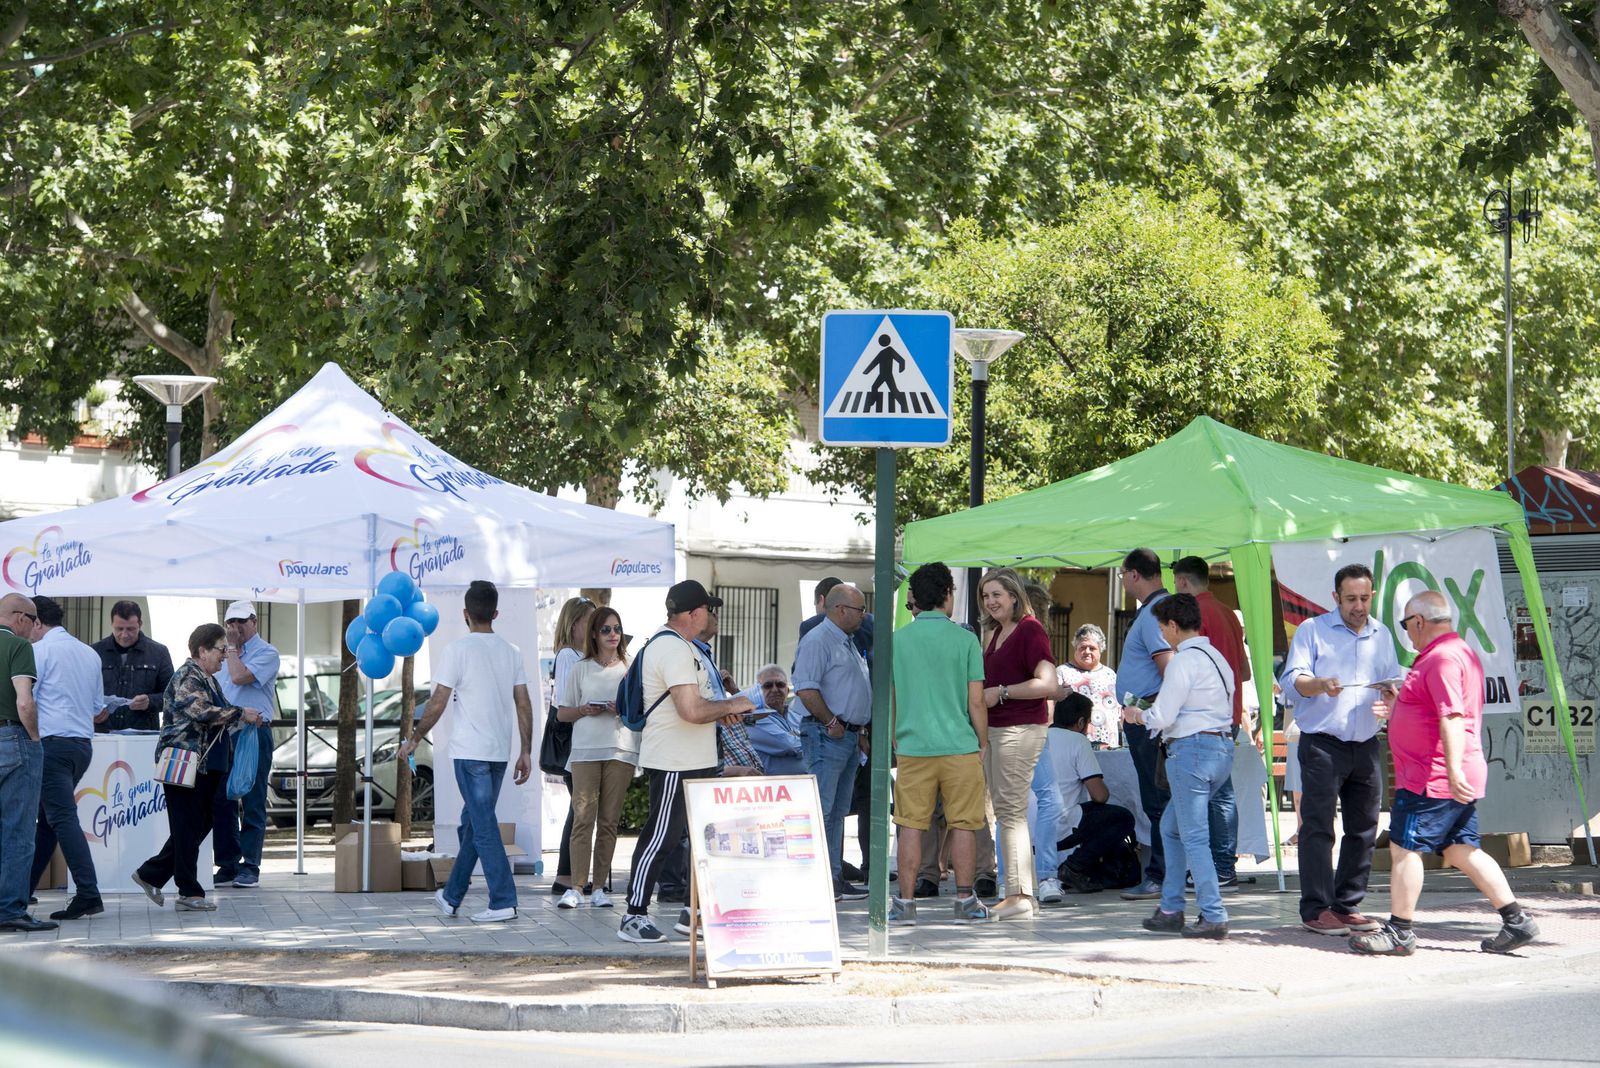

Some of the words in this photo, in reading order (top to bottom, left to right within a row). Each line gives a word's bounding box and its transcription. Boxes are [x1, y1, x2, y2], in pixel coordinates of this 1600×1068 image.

[167, 451, 341, 506] Granada
[25, 542, 92, 595] Granada
[286, 562, 349, 577] populares
[410, 537, 465, 587] Granada
[615, 561, 662, 576] populares
[112, 782, 124, 808] La
[129, 780, 152, 807] gran
[713, 785, 792, 804] MAMA
[93, 784, 167, 848] Granada
[759, 953, 780, 966] 100
